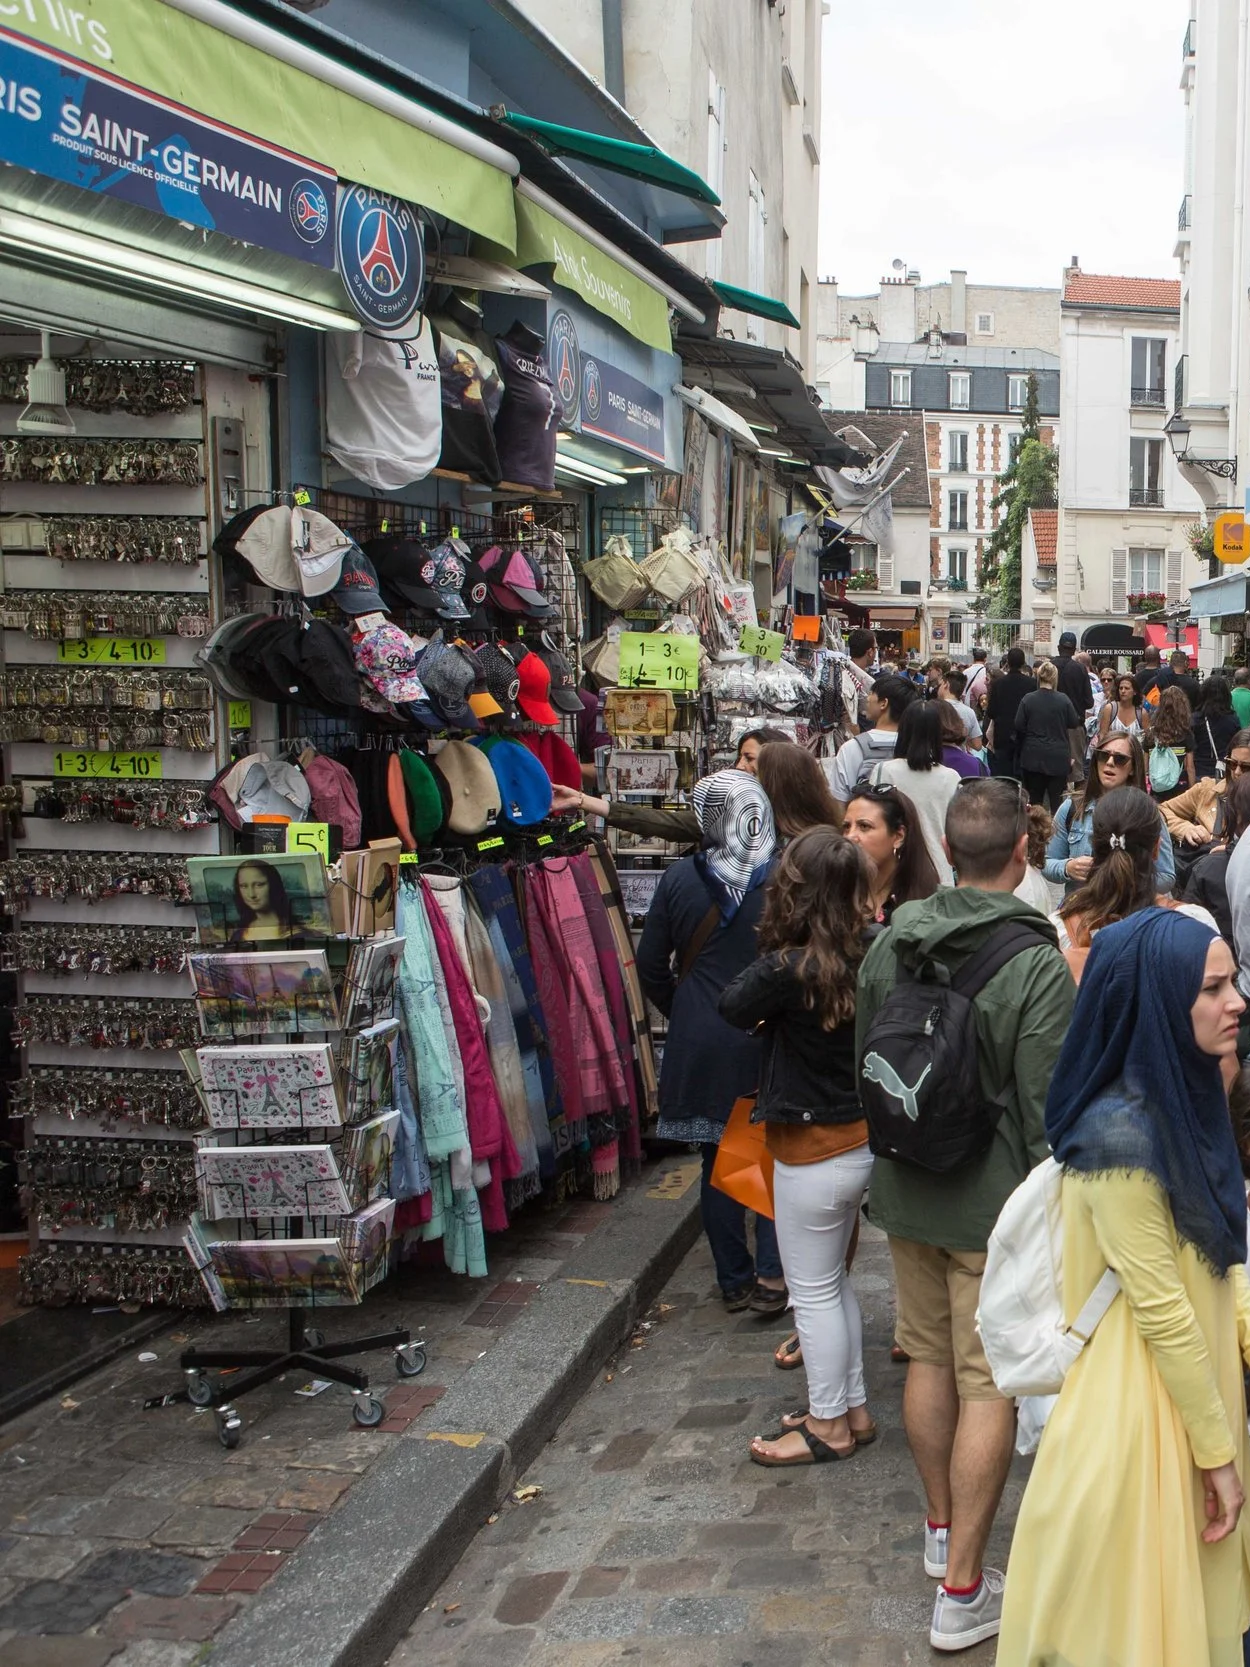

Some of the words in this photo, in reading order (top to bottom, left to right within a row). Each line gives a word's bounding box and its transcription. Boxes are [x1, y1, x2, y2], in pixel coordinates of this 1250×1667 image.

[52, 133, 94, 155] PRODUIT
[94, 150, 118, 166] SOUS
[119, 157, 154, 178] LICENCE
[154, 172, 200, 195] OFFICIELLE
[60, 104, 282, 213] SAINT-GERMAIN
[316, 194, 328, 236] PARIS
[355, 188, 410, 231] PARIS
[608, 391, 627, 412] PARIS
[1222, 543, 1243, 551] Kodak
